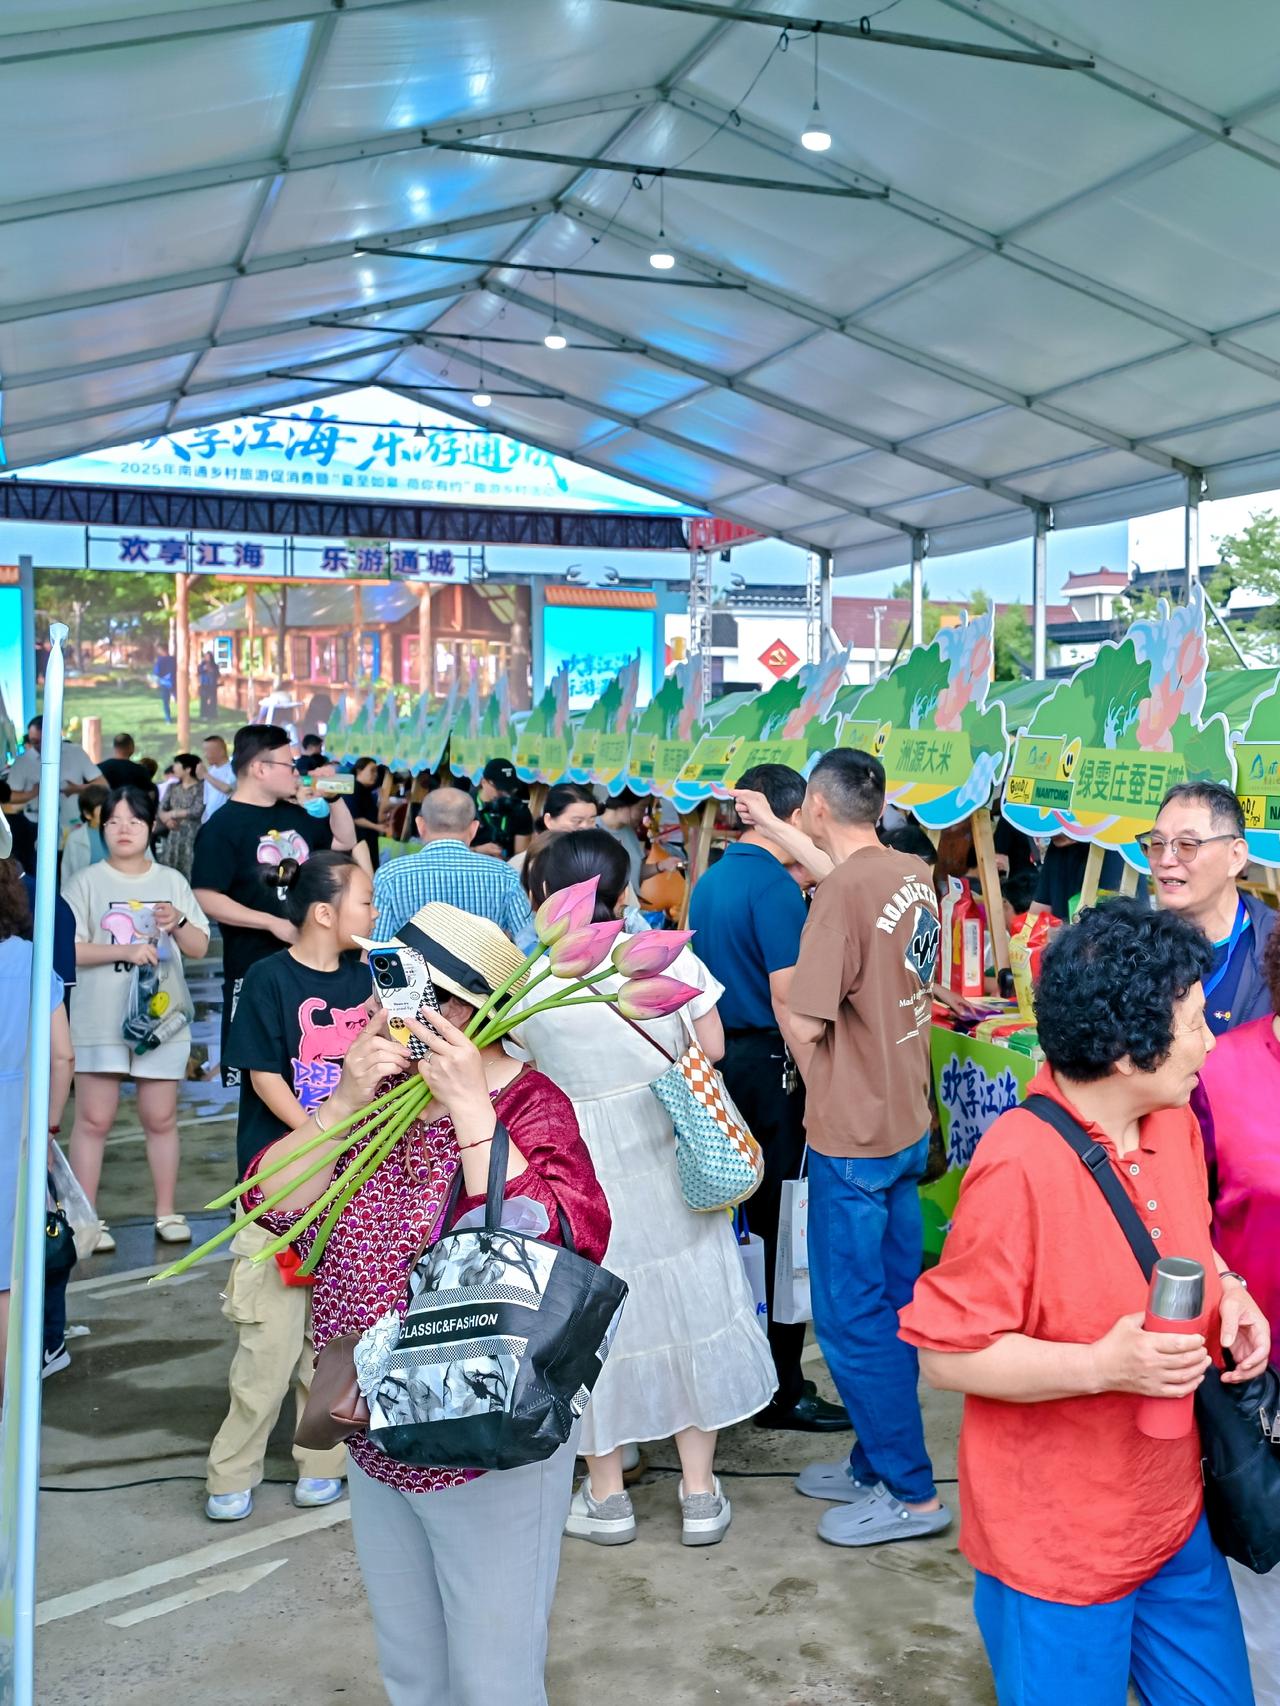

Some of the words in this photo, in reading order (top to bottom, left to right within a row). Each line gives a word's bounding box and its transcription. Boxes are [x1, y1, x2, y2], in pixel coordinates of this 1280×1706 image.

[119, 535, 265, 568] 欢享江海
[320, 546, 456, 576] 乐游通城
[399, 1313, 499, 1340] CLASSIC&FASHION
